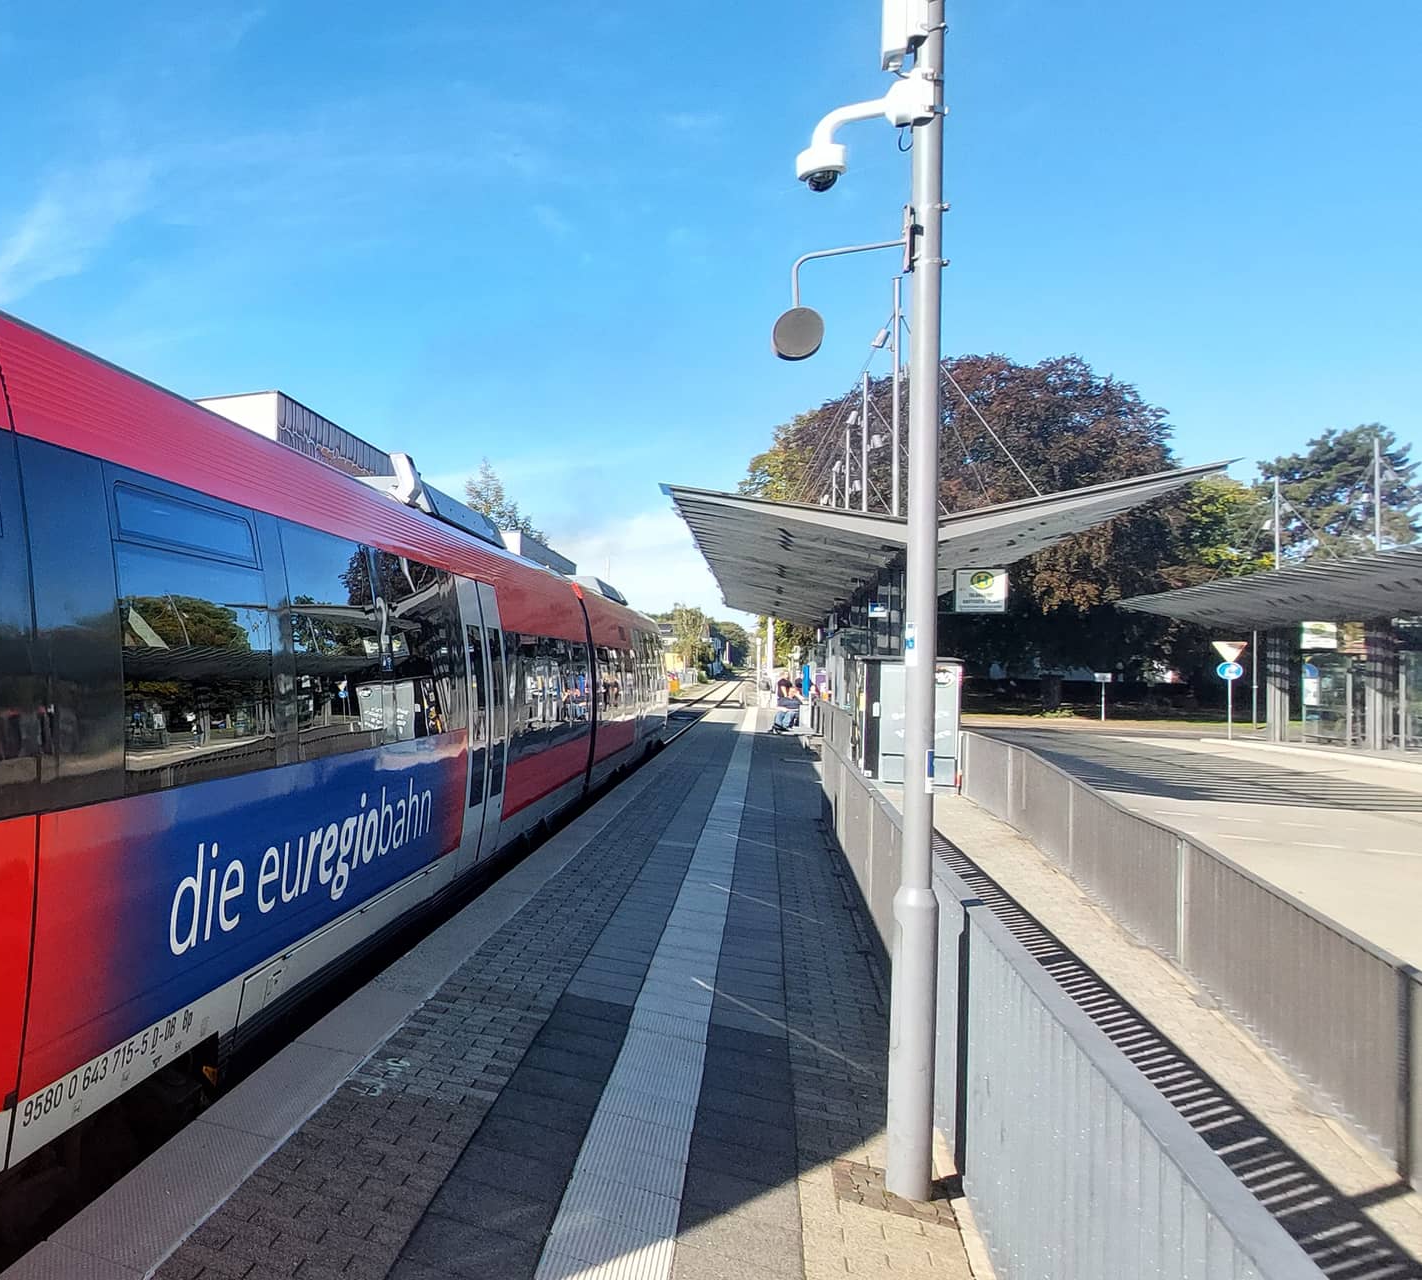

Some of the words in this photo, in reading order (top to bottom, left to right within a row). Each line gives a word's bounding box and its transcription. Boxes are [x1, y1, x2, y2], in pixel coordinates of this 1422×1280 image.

[169, 842, 245, 956] die
[257, 777, 433, 914] euregiobahn
[22, 1079, 63, 1127] 9580
[68, 1074, 78, 1100] 0
[82, 1057, 108, 1091] 643
[111, 1032, 148, 1074] 715-5
